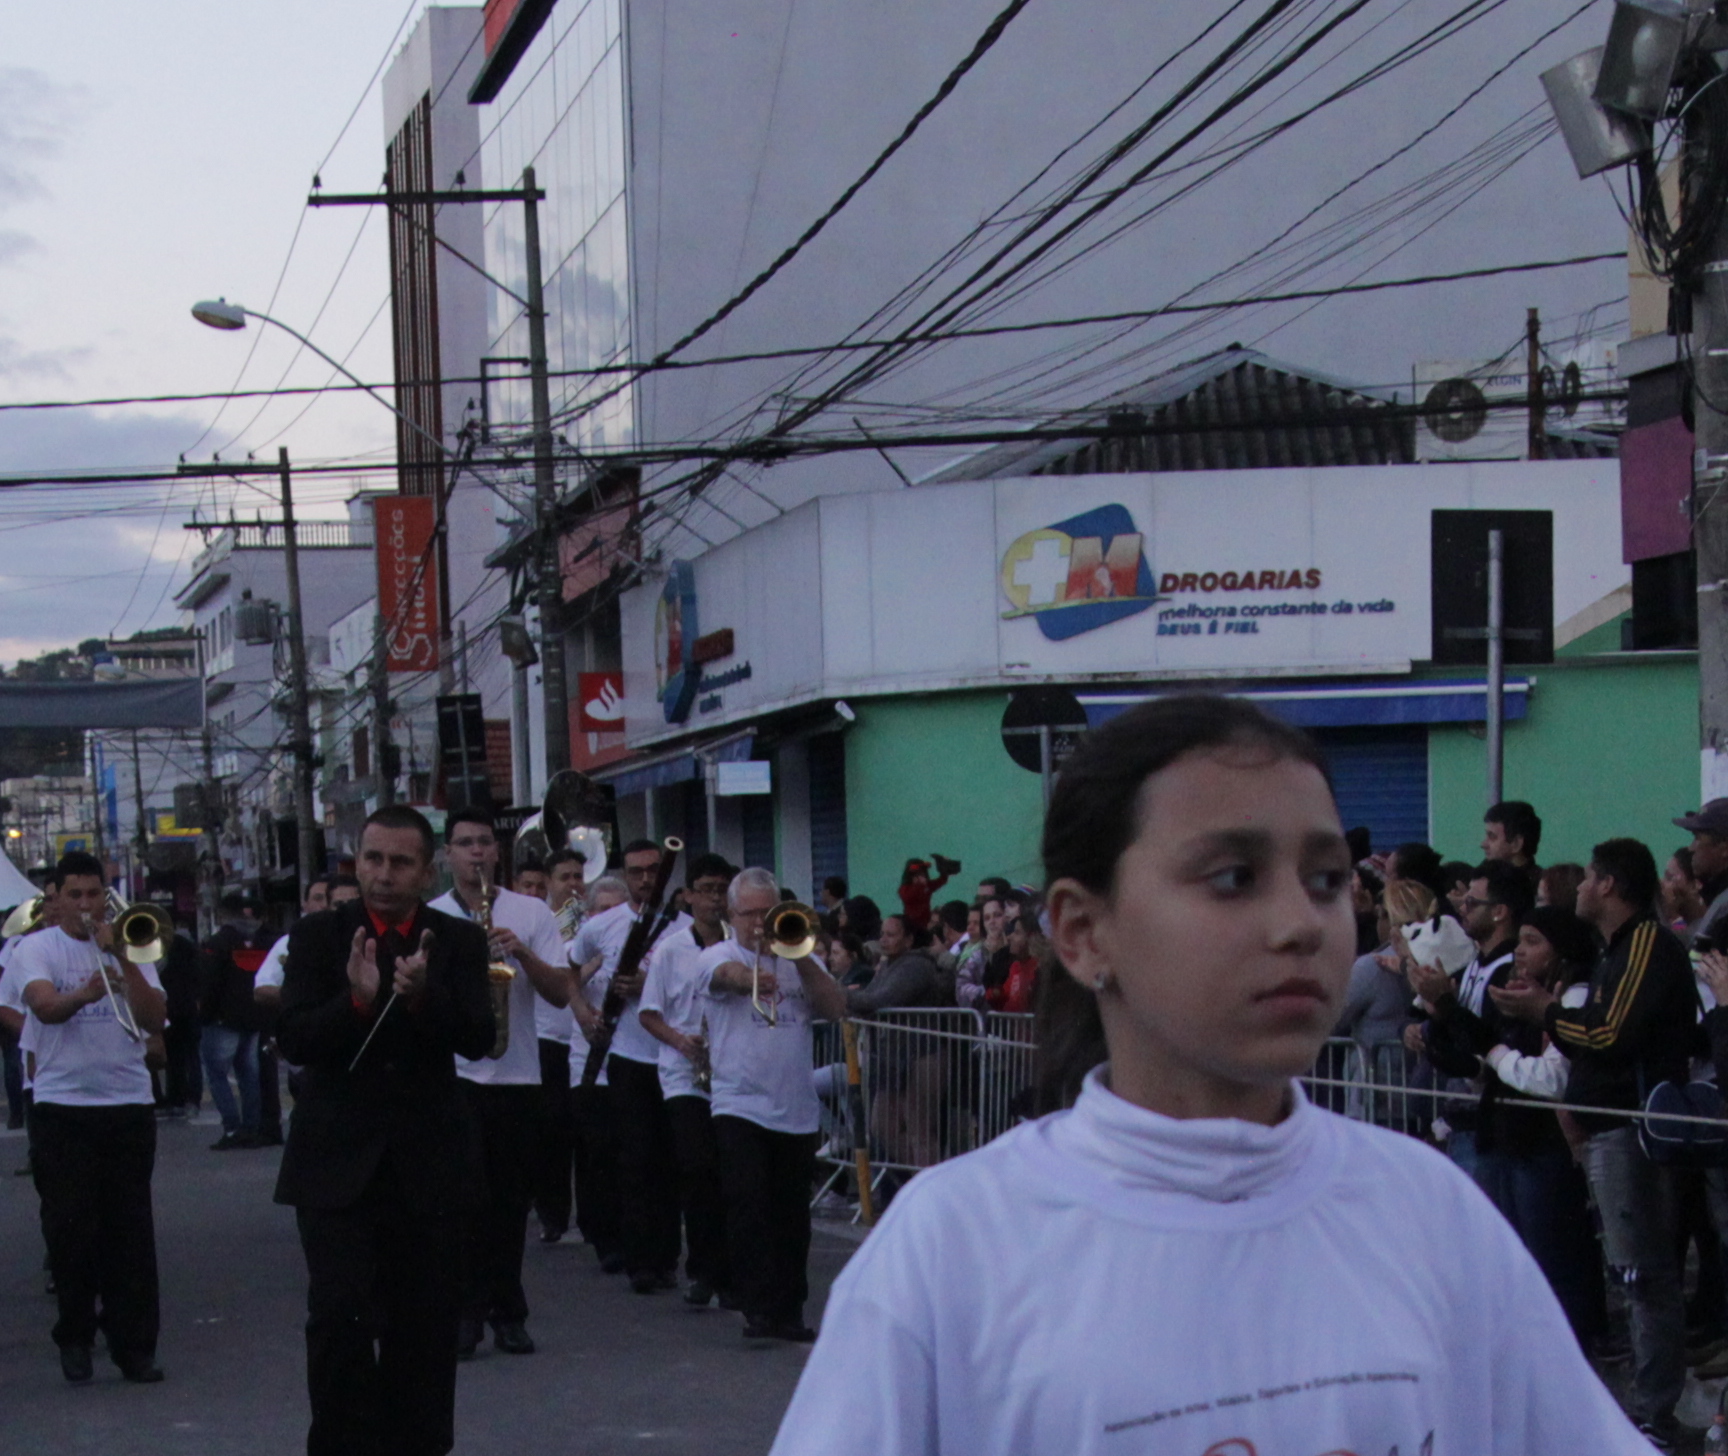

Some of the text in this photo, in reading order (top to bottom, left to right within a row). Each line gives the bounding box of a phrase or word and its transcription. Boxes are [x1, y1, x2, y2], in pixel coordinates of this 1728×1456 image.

[1159, 568, 1321, 594] DROGARIAS
[1240, 601, 1327, 617] constante
[1331, 600, 1353, 615] da
[1357, 598, 1394, 613] vida
[1157, 621, 1201, 636] DEUS
